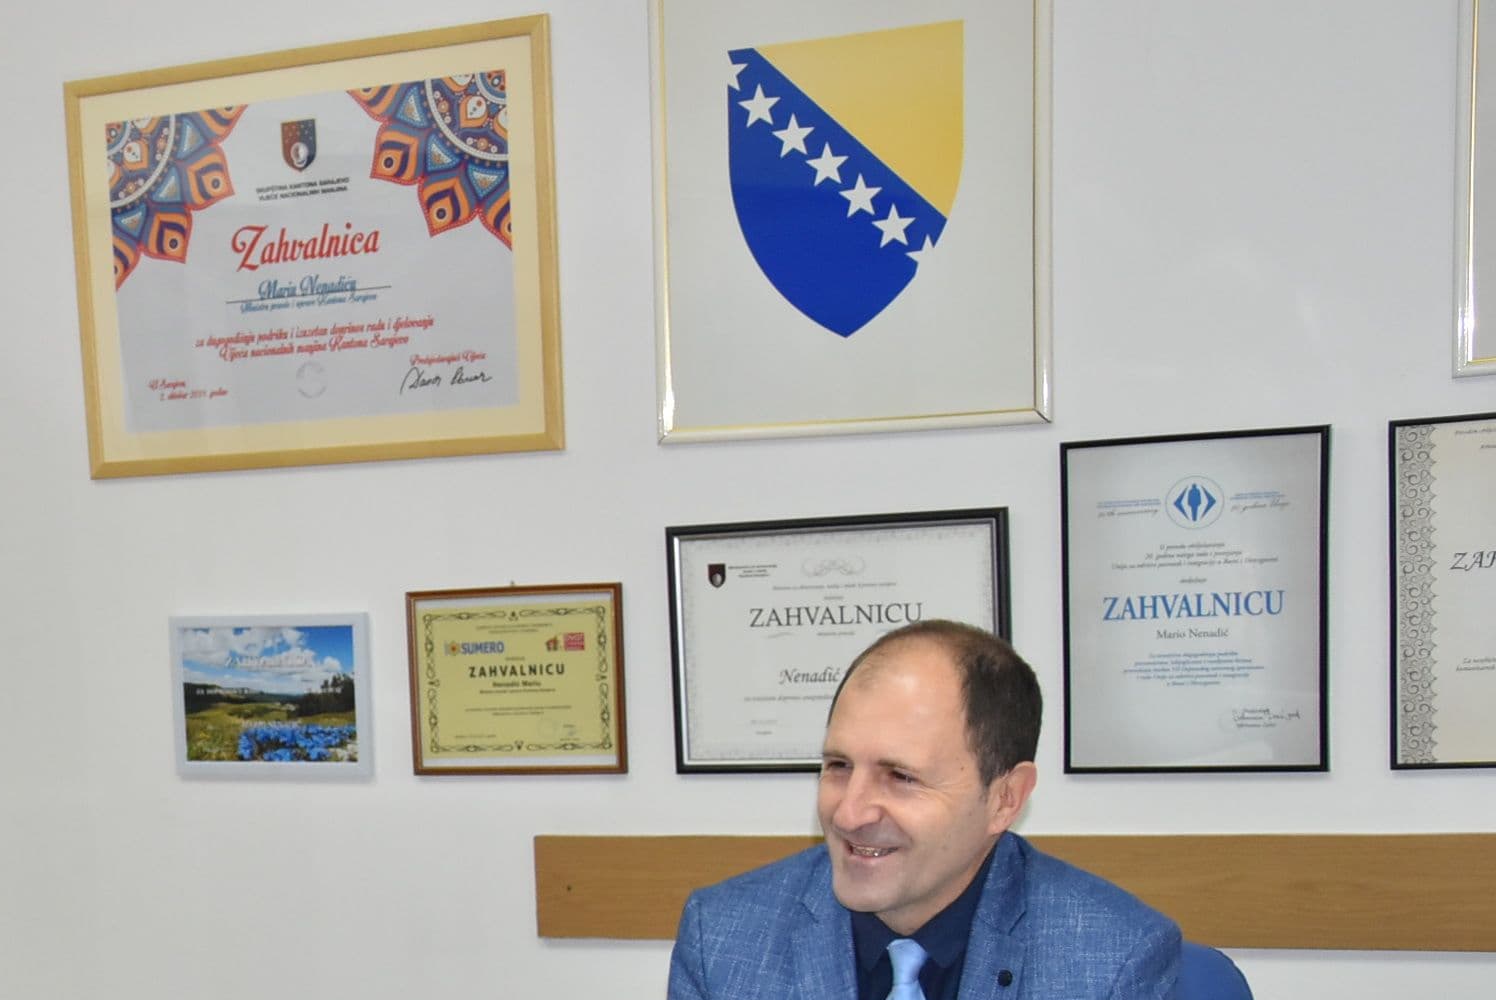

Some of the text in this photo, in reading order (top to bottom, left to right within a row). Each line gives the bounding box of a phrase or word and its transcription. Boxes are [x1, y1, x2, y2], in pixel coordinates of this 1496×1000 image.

[231, 222, 380, 272] Zahvalnica
[749, 602, 923, 628] ZAHVALNICU
[1102, 590, 1285, 621] ZAHVALNICU
[1156, 627, 1229, 640] Mario Nenadić
[461, 641, 504, 655] SUMERO
[469, 663, 565, 678] ZAHVALNICU
[778, 666, 841, 685] Nenadić
